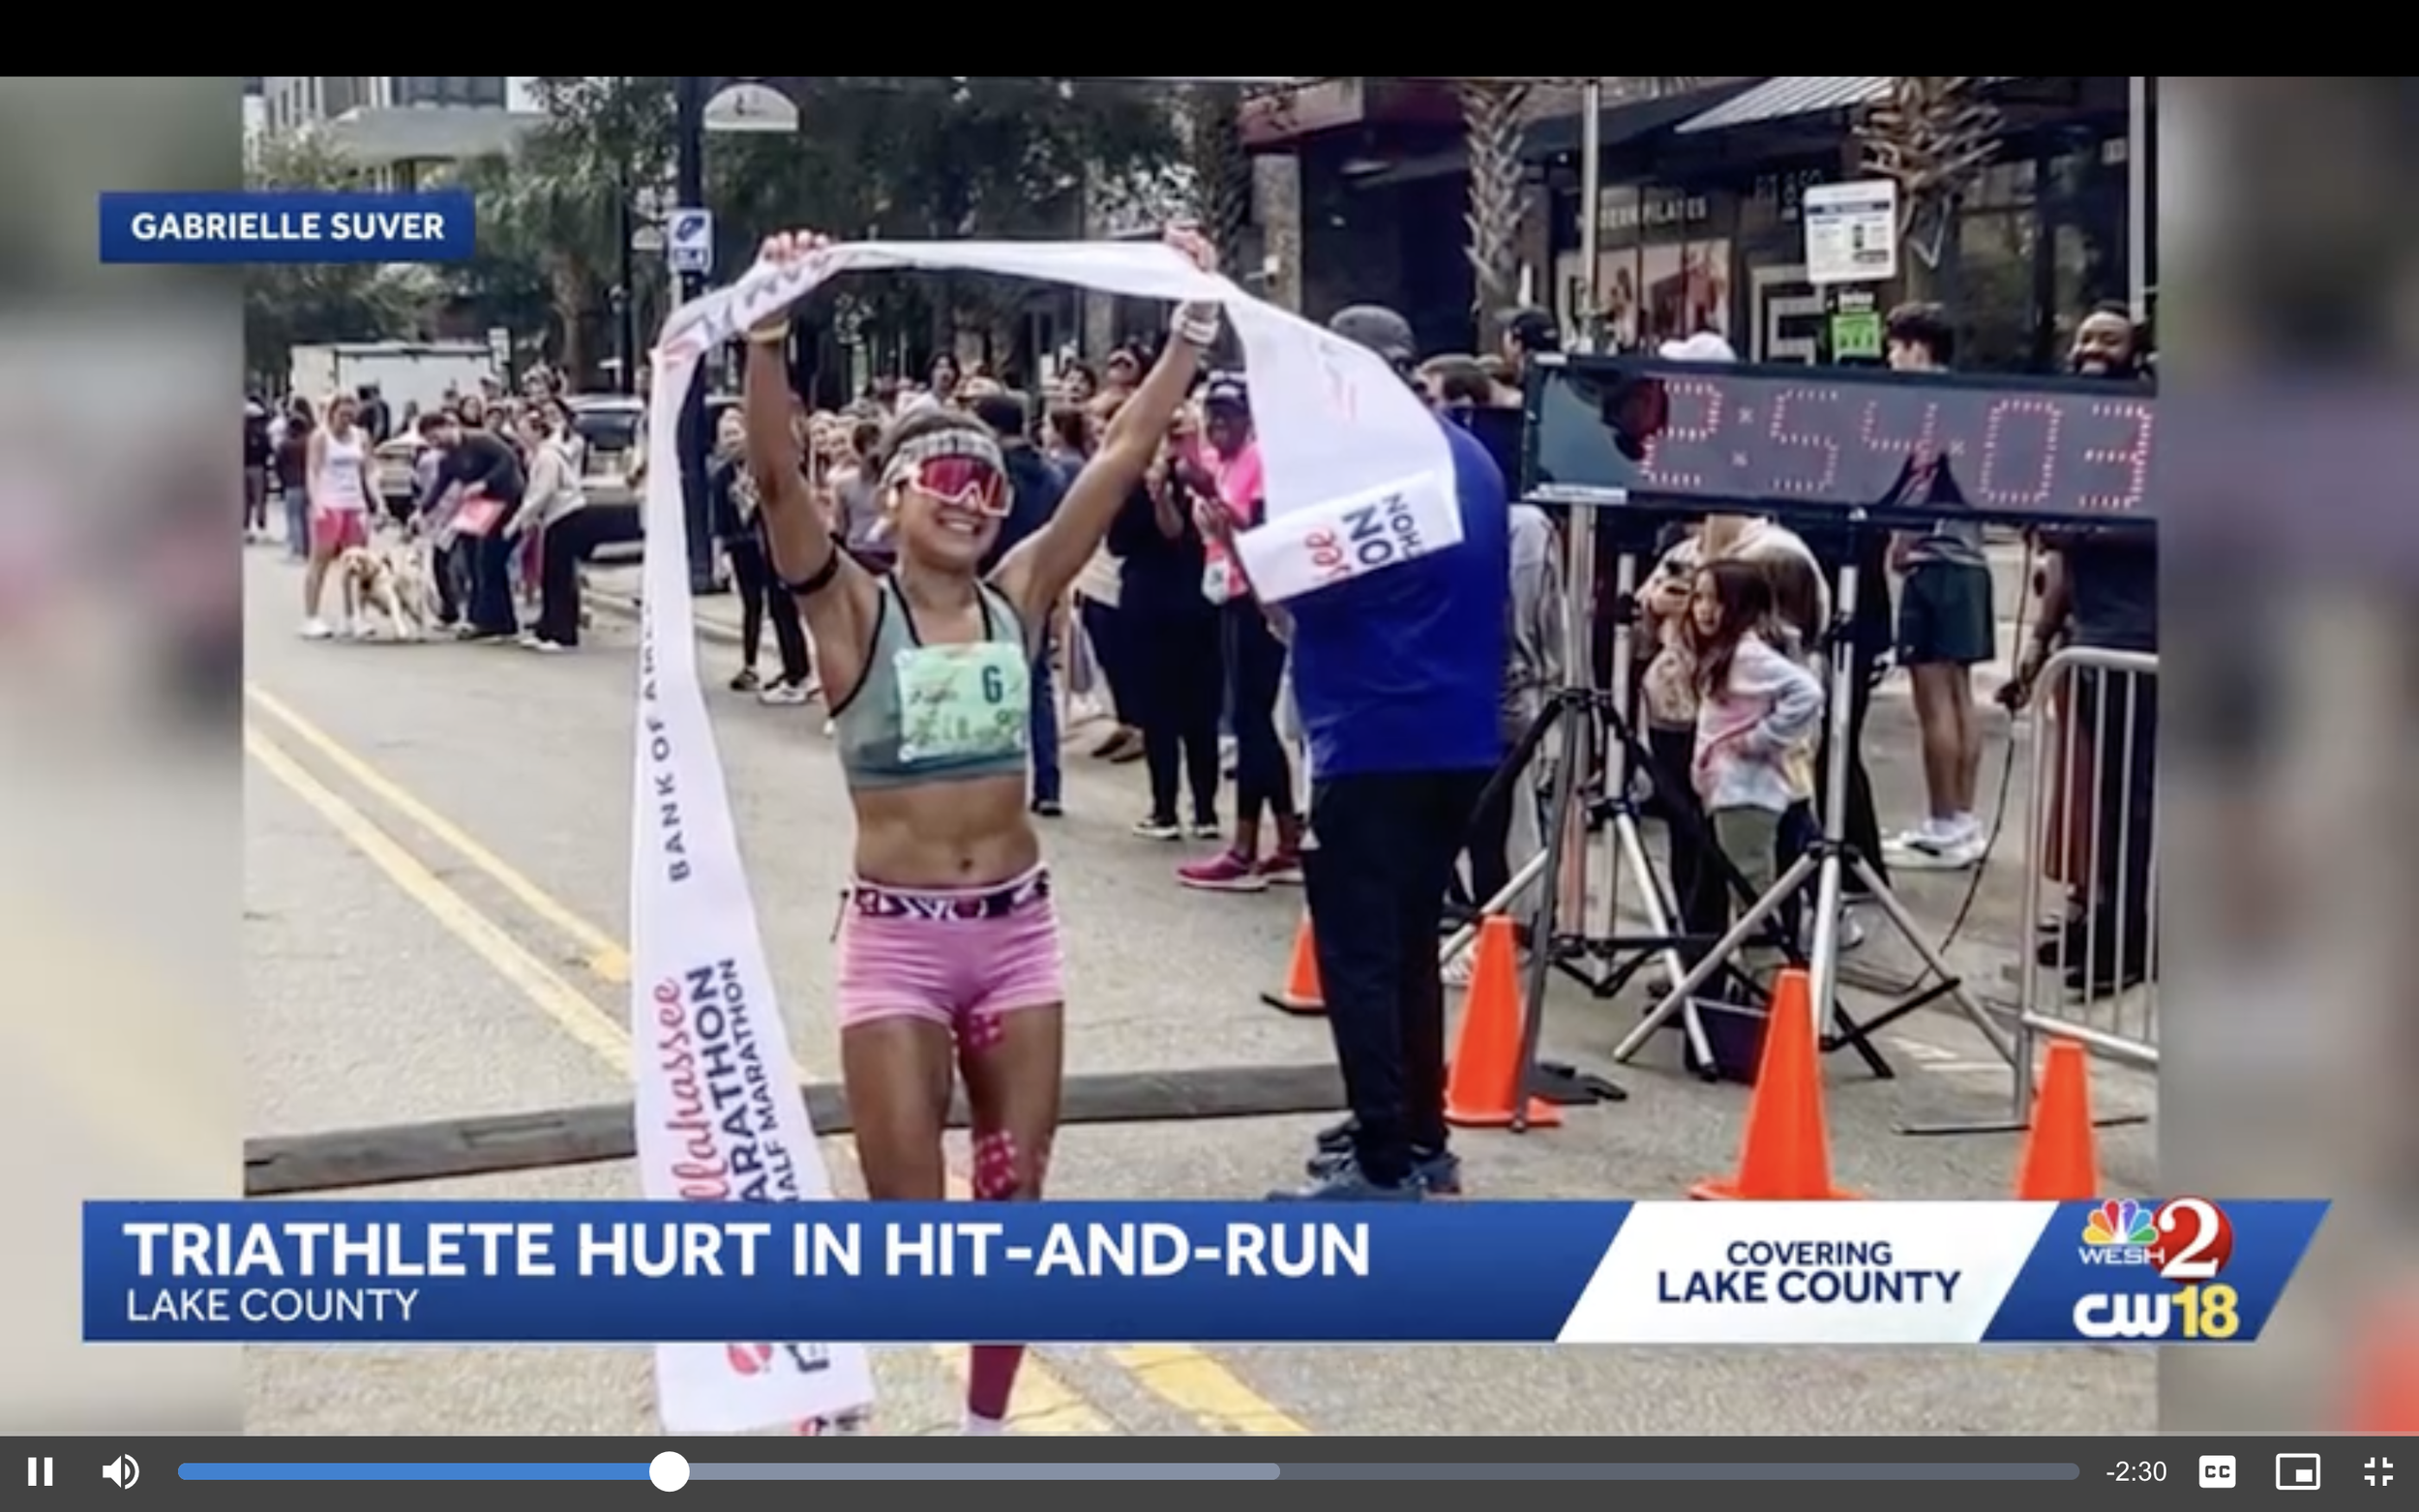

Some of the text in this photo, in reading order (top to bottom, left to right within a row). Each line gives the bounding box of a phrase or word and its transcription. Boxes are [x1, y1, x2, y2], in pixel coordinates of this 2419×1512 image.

[981, 665, 1003, 704] 6
[645, 716, 671, 762] OF
[655, 774, 691, 881] BANK
[685, 965, 771, 1201] ARATHON
[718, 957, 779, 1132] MARATHON
